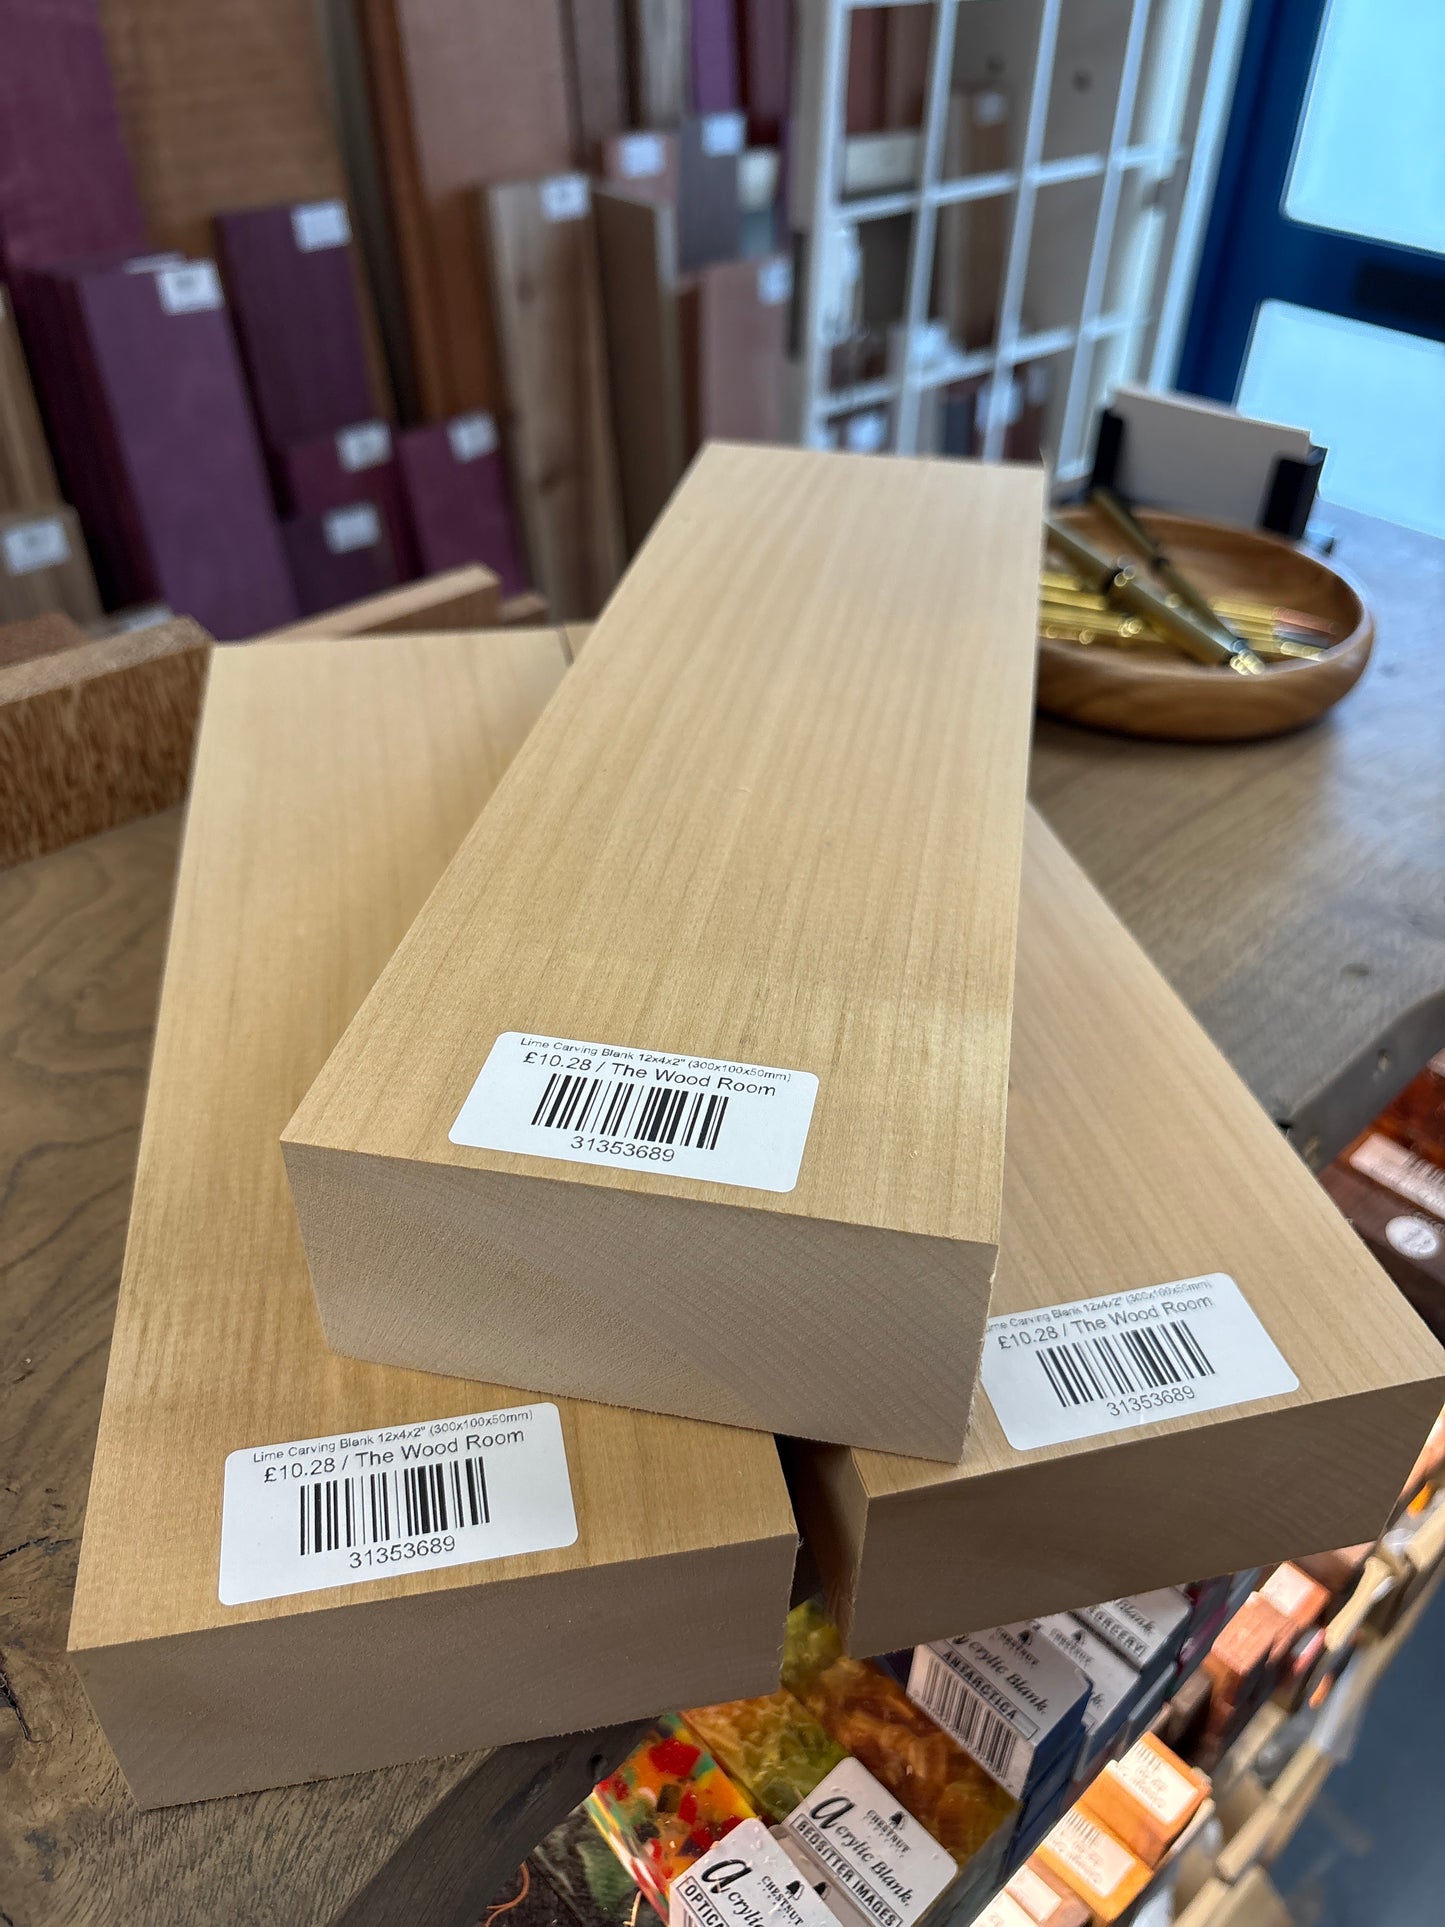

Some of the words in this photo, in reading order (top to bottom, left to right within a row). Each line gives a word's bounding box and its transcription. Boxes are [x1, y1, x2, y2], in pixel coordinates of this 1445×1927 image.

[520, 1037, 550, 1050] Lime
[553, 1042, 598, 1057] Carving
[602, 1048, 635, 1061] Blank
[639, 1053, 686, 1067] 12x4x2"
[688, 1060, 792, 1082] (300x100x50mm)
[523, 1051, 592, 1072] £10.28
[596, 1061, 605, 1073] /
[612, 1063, 648, 1079] The
[655, 1069, 710, 1088] Wood
[717, 1077, 777, 1097] Room
[570, 1136, 676, 1163] 31353689
[998, 1325, 1059, 1351] £10.28
[1070, 1315, 1106, 1335] The
[1110, 1304, 1160, 1327] Wood
[1164, 1294, 1214, 1316] Room
[1106, 1386, 1196, 1417] 31353689
[253, 1449, 284, 1463] Lime
[288, 1441, 336, 1458] Carving
[340, 1433, 375, 1449] Blank
[378, 1425, 426, 1442] 12x4x2"
[429, 1409, 534, 1436] (300x100x50mm)
[263, 1459, 335, 1483] £10.28
[341, 1455, 349, 1471] /
[355, 1448, 394, 1467] The
[401, 1438, 459, 1460] Wood
[466, 1428, 526, 1451] Room
[349, 1535, 456, 1570] 31353689
[943, 1650, 1018, 1720] ANTARCTICA
[866, 1809, 912, 1853] CHESTNUT
[796, 1820, 854, 1882] BEDSITTER
[852, 1880, 897, 1927] IMAGES
[761, 1875, 804, 1925] CHESTNUT
